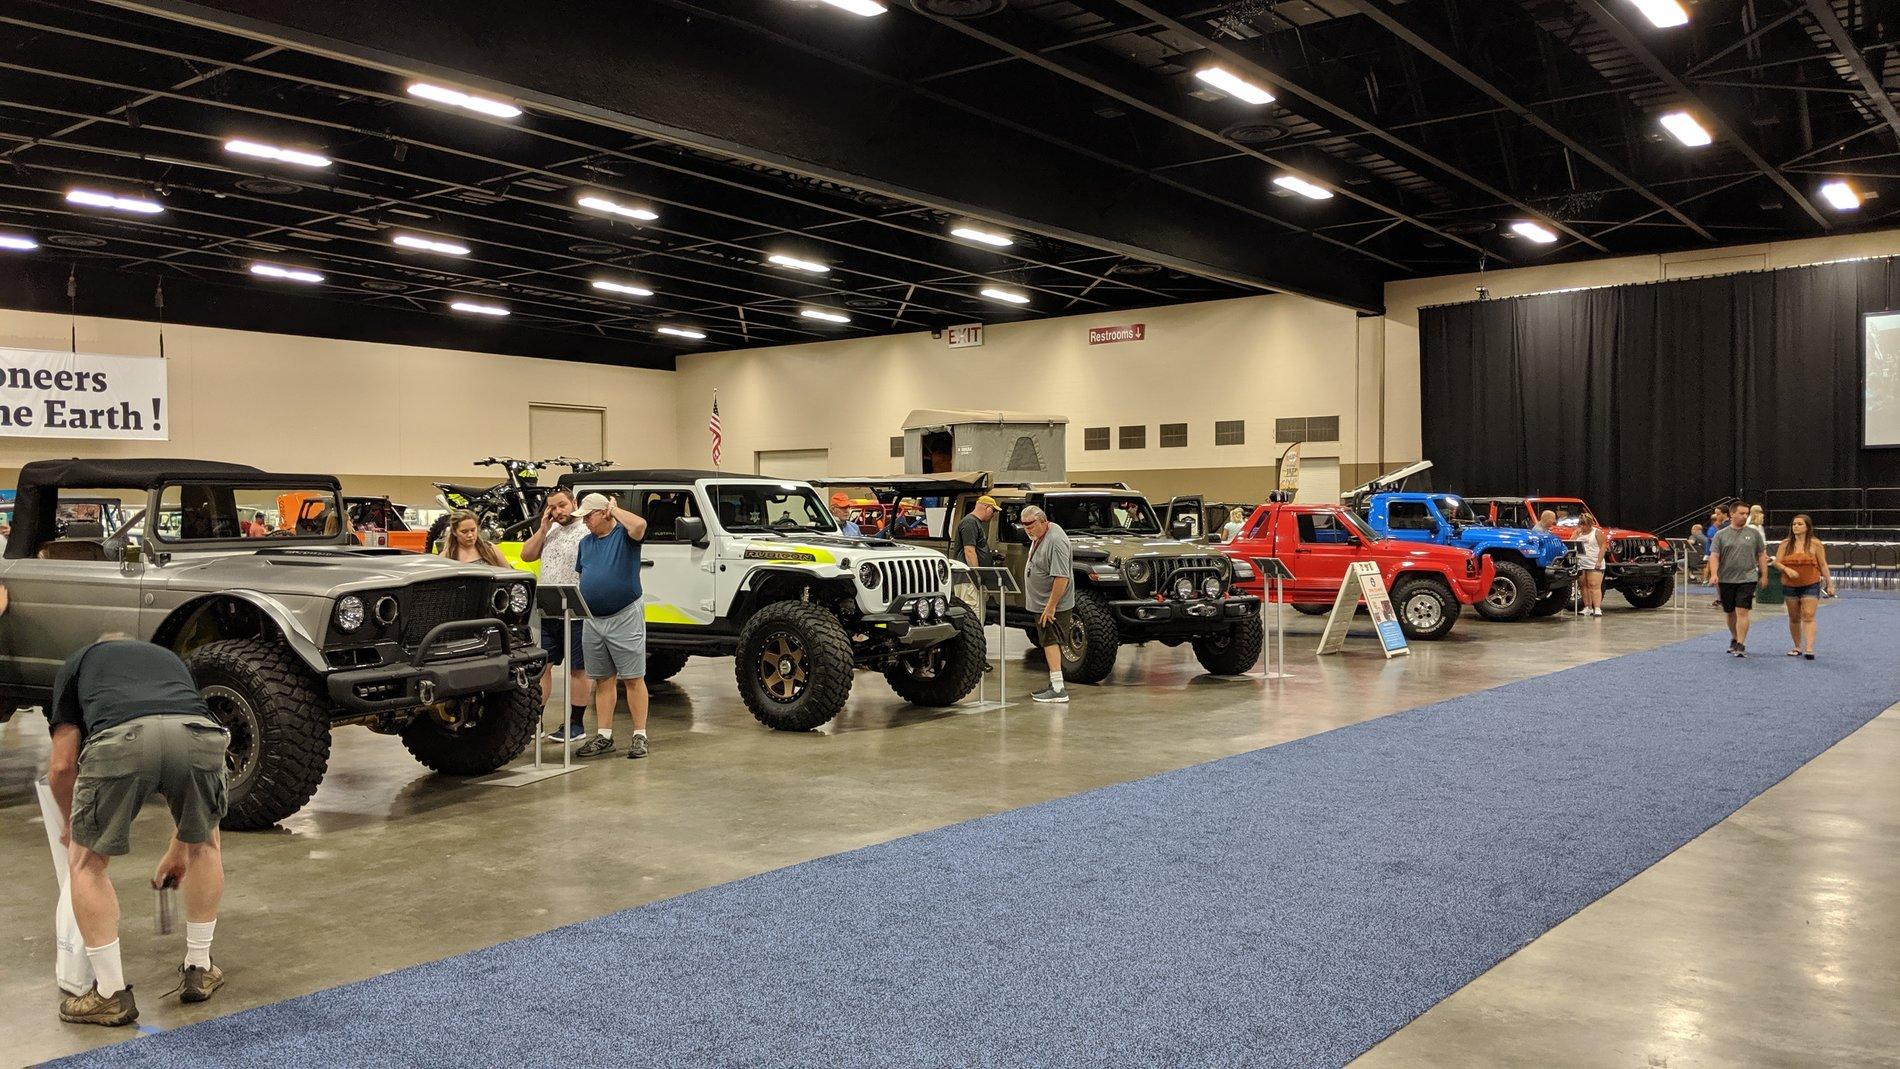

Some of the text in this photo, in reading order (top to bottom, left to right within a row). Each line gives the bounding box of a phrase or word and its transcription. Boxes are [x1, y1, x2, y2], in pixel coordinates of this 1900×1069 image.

[949, 327, 981, 344] EXIT
[1090, 327, 1134, 343] Restrooms
[745, 550, 812, 560] RUBICON
